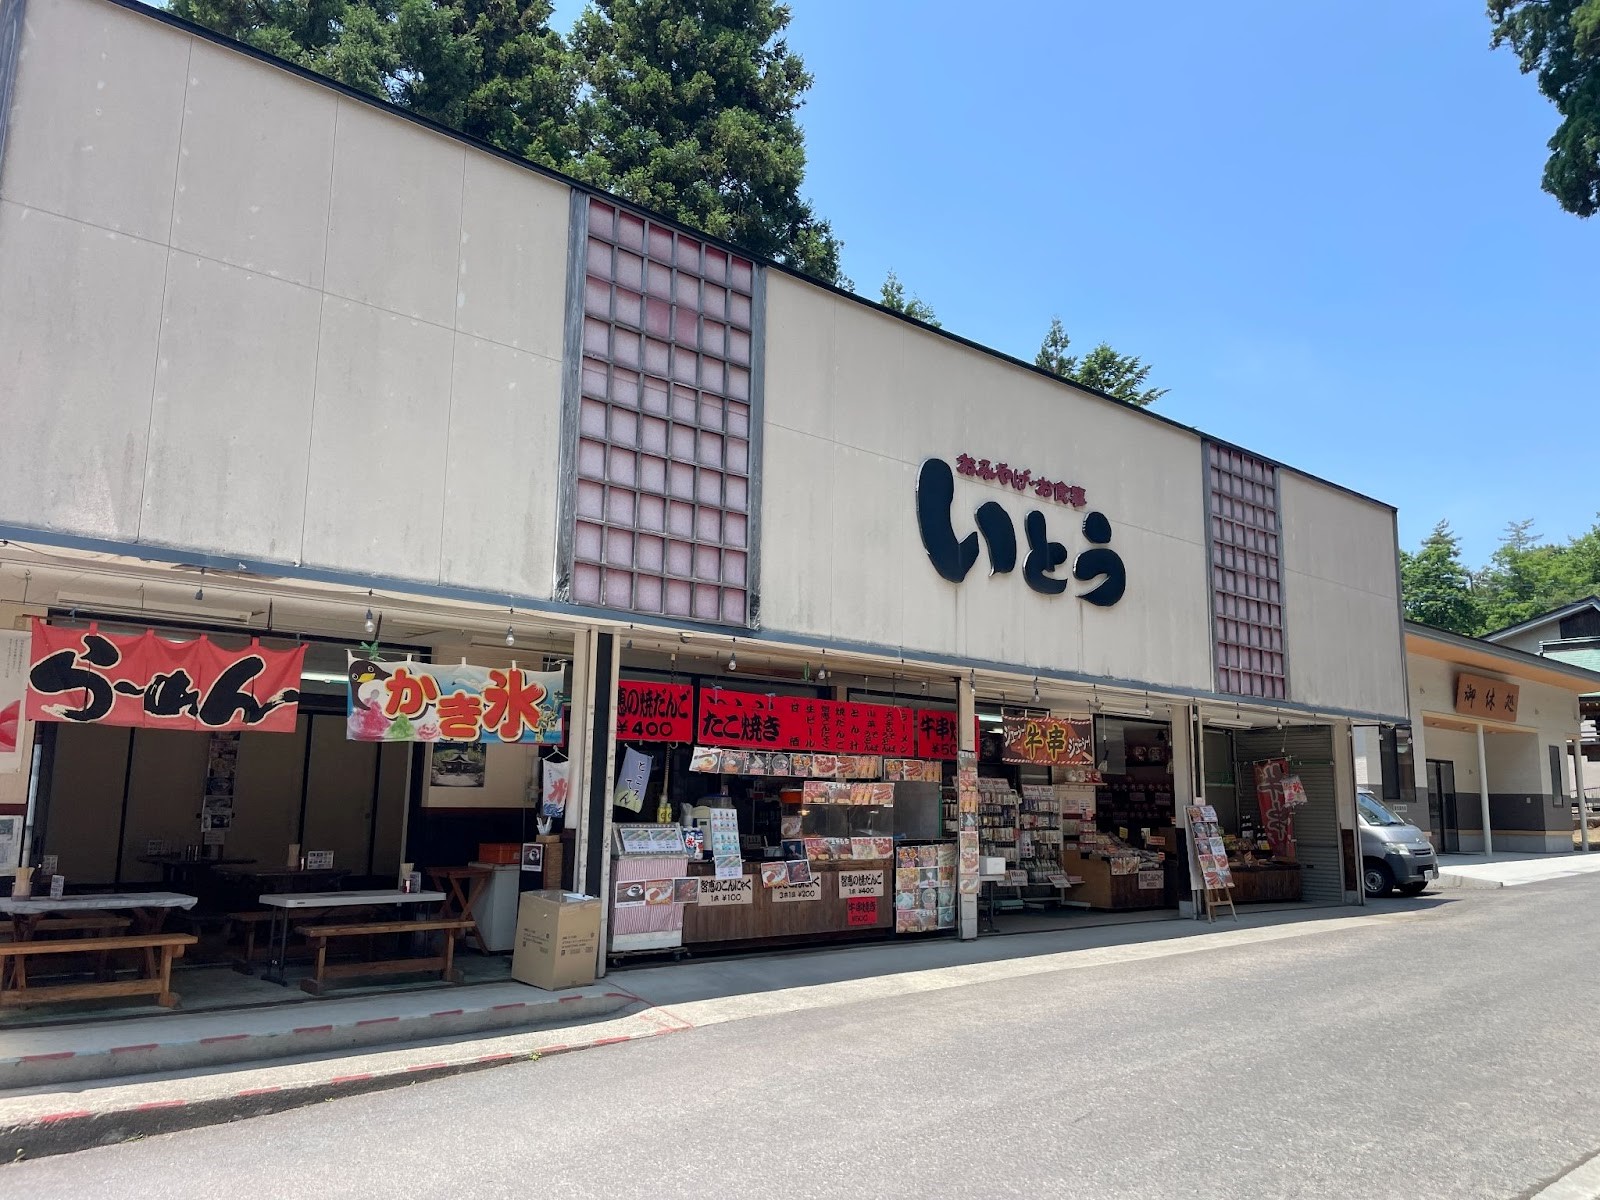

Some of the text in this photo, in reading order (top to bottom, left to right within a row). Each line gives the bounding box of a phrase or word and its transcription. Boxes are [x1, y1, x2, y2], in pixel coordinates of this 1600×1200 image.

[915, 458, 1127, 607] いとう
[30, 633, 300, 727] らーめん
[384, 667, 546, 742] かき氷
[617, 721, 672, 737] ¥400
[703, 710, 781, 742] たこ焼き
[805, 704, 815, 748] 生ビール
[1024, 722, 1067, 761] 牛串
[722, 893, 741, 902] ¥100
